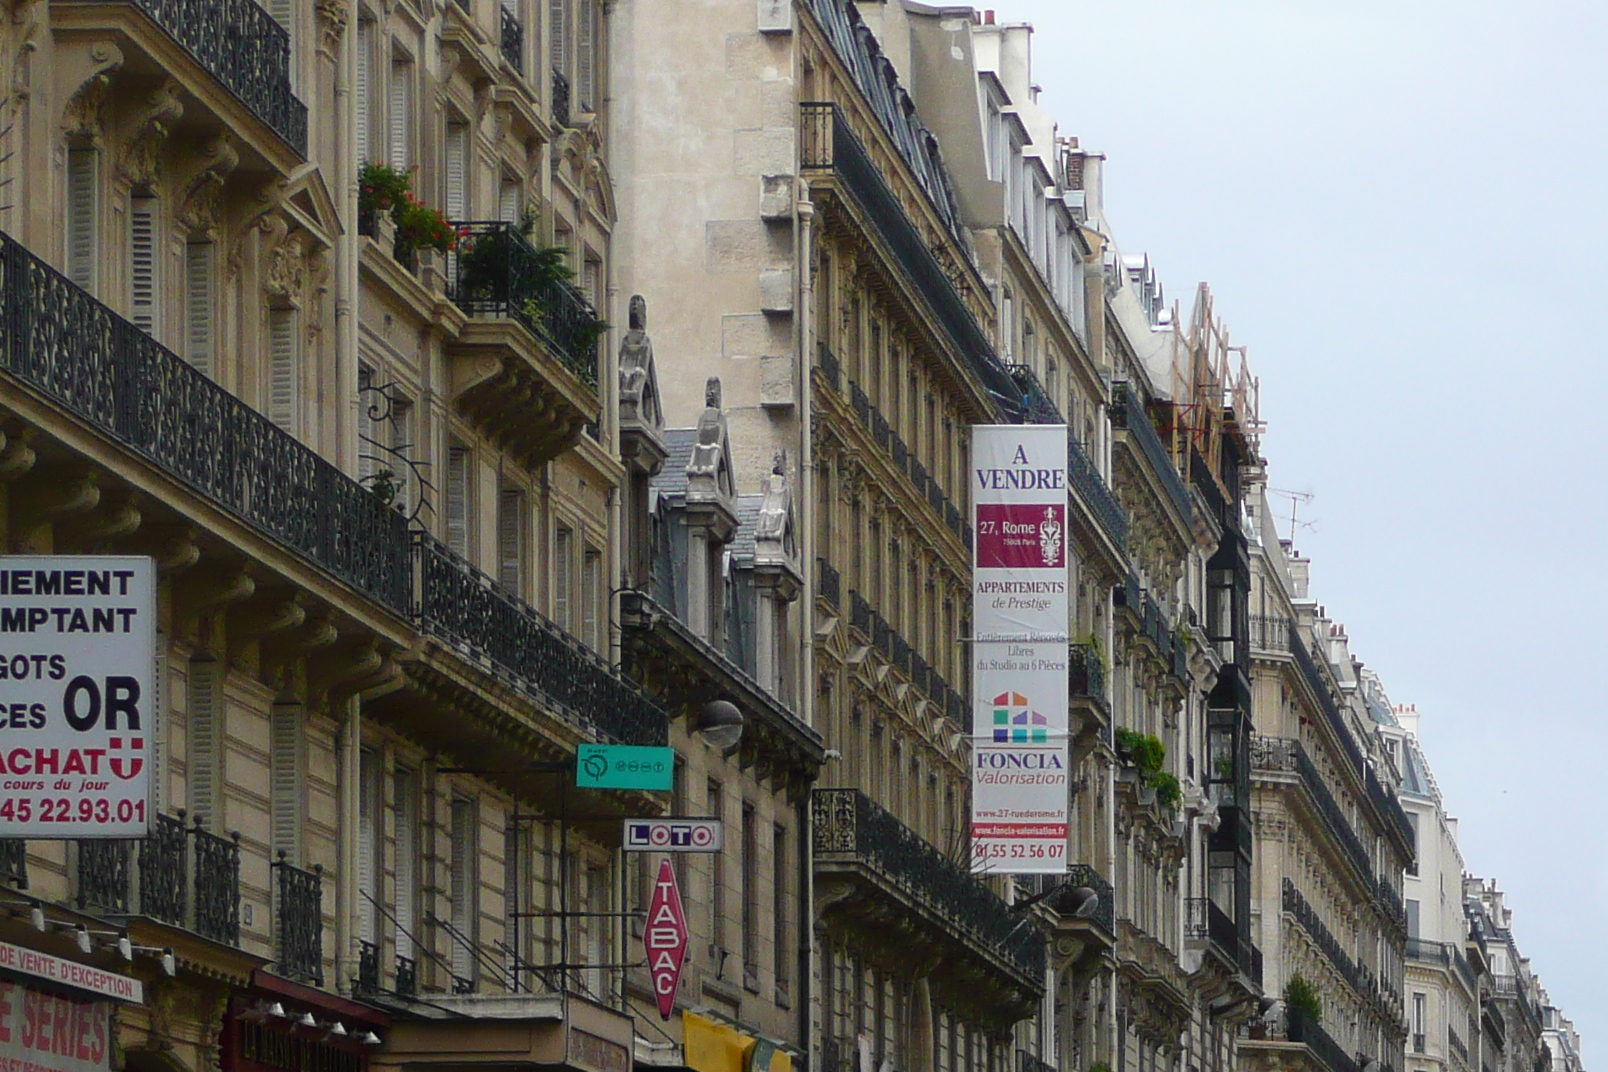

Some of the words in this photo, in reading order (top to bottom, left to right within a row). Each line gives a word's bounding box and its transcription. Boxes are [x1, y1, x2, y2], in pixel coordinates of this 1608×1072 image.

[1012, 445, 1028, 464] A
[976, 469, 1065, 489] VENDRE
[980, 521, 998, 536] 27,
[1003, 521, 1036, 534] Rome
[1, 570, 134, 595] IEMENT
[977, 582, 1064, 593] APPARTEMENTS
[992, 597, 1006, 608] de
[1007, 597, 1051, 611] Prestige
[1, 608, 137, 633] MPTANT
[1008, 645, 1034, 657] Libres
[977, 660, 988, 670] du
[989, 659, 1017, 671] Studio
[1019, 662, 1029, 670] au
[1031, 660, 1037, 670] 6
[1039, 659, 1065, 670] Pièces
[63, 674, 141, 732] OR
[976, 752, 1062, 769] FONCIA
[3, 780, 44, 790] cours
[53, 779, 72, 790] du
[79, 779, 110, 793] jour
[976, 770, 1065, 785] Valorisation
[39, 798, 145, 823] 22.93.01
[629, 825, 713, 846] LOTO
[993, 844, 1007, 857] 55
[1011, 844, 1025, 857] 52
[1030, 844, 1044, 857] 56
[1048, 844, 1064, 857] 07
[650, 882, 680, 994] TABAC
[1, 947, 15, 966] DE
[19, 950, 56, 976] VENTE
[61, 963, 133, 998] D'EXCEPTION
